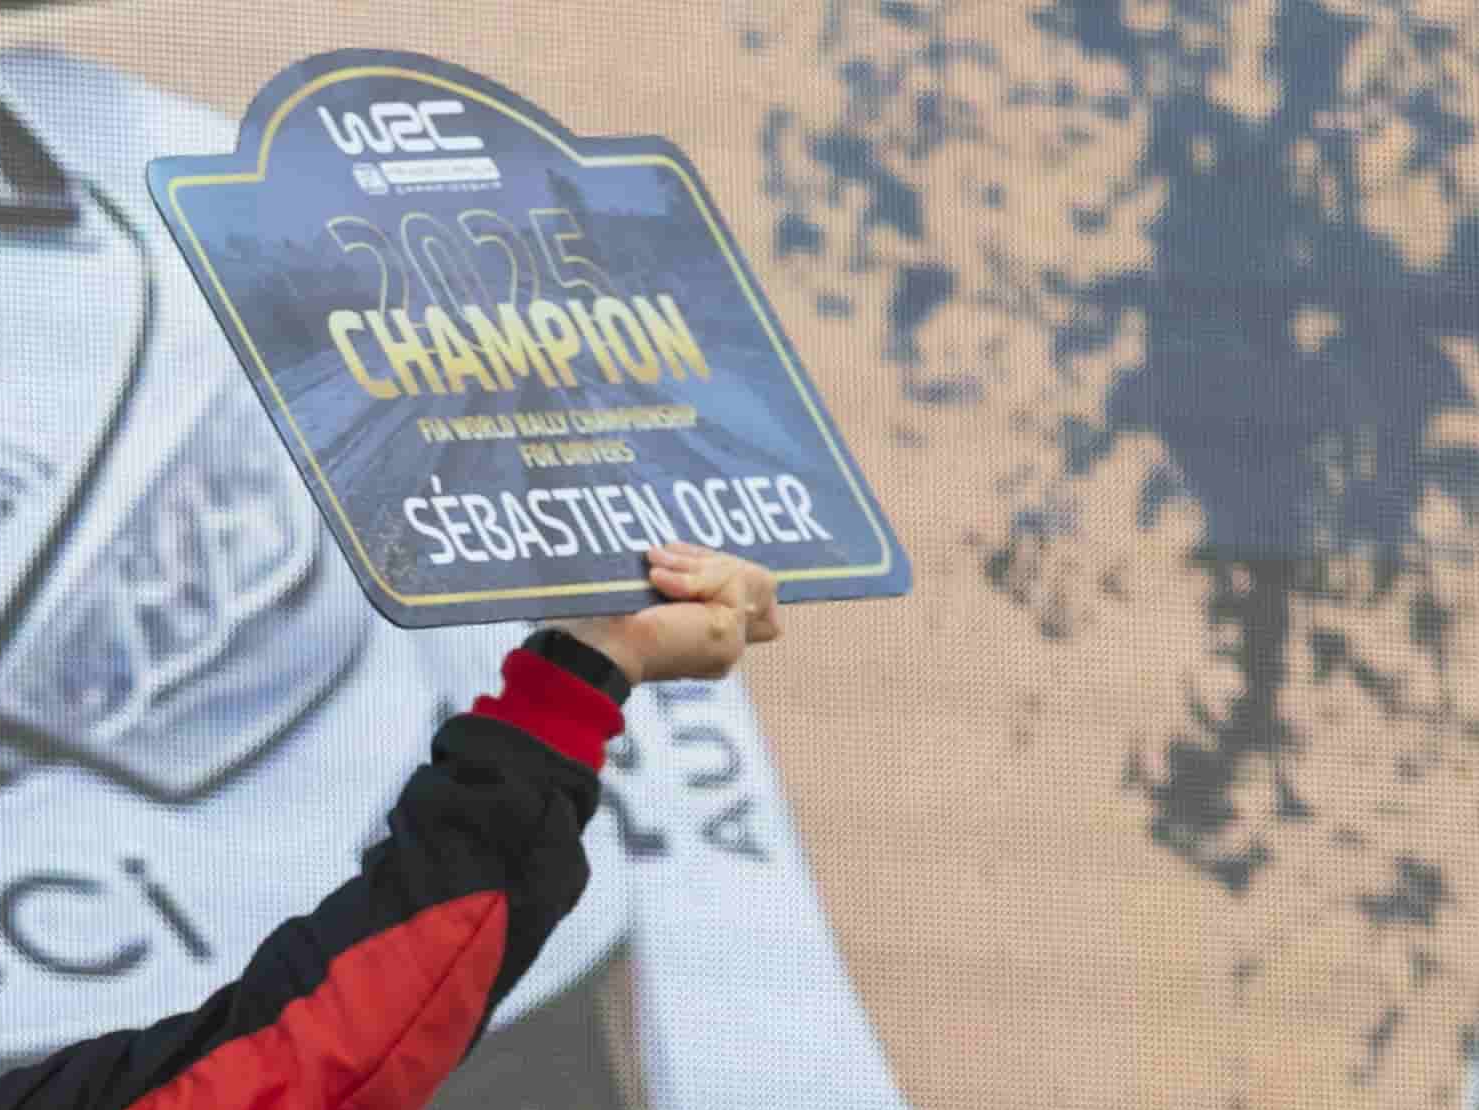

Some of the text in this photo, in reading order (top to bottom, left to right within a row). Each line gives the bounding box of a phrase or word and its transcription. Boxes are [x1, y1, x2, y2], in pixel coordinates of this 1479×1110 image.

[317, 100, 485, 155] WRC
[327, 208, 621, 350] 2025
[328, 294, 712, 399] CHAMPION
[403, 474, 834, 566] SÉBASTIEN OGIER
